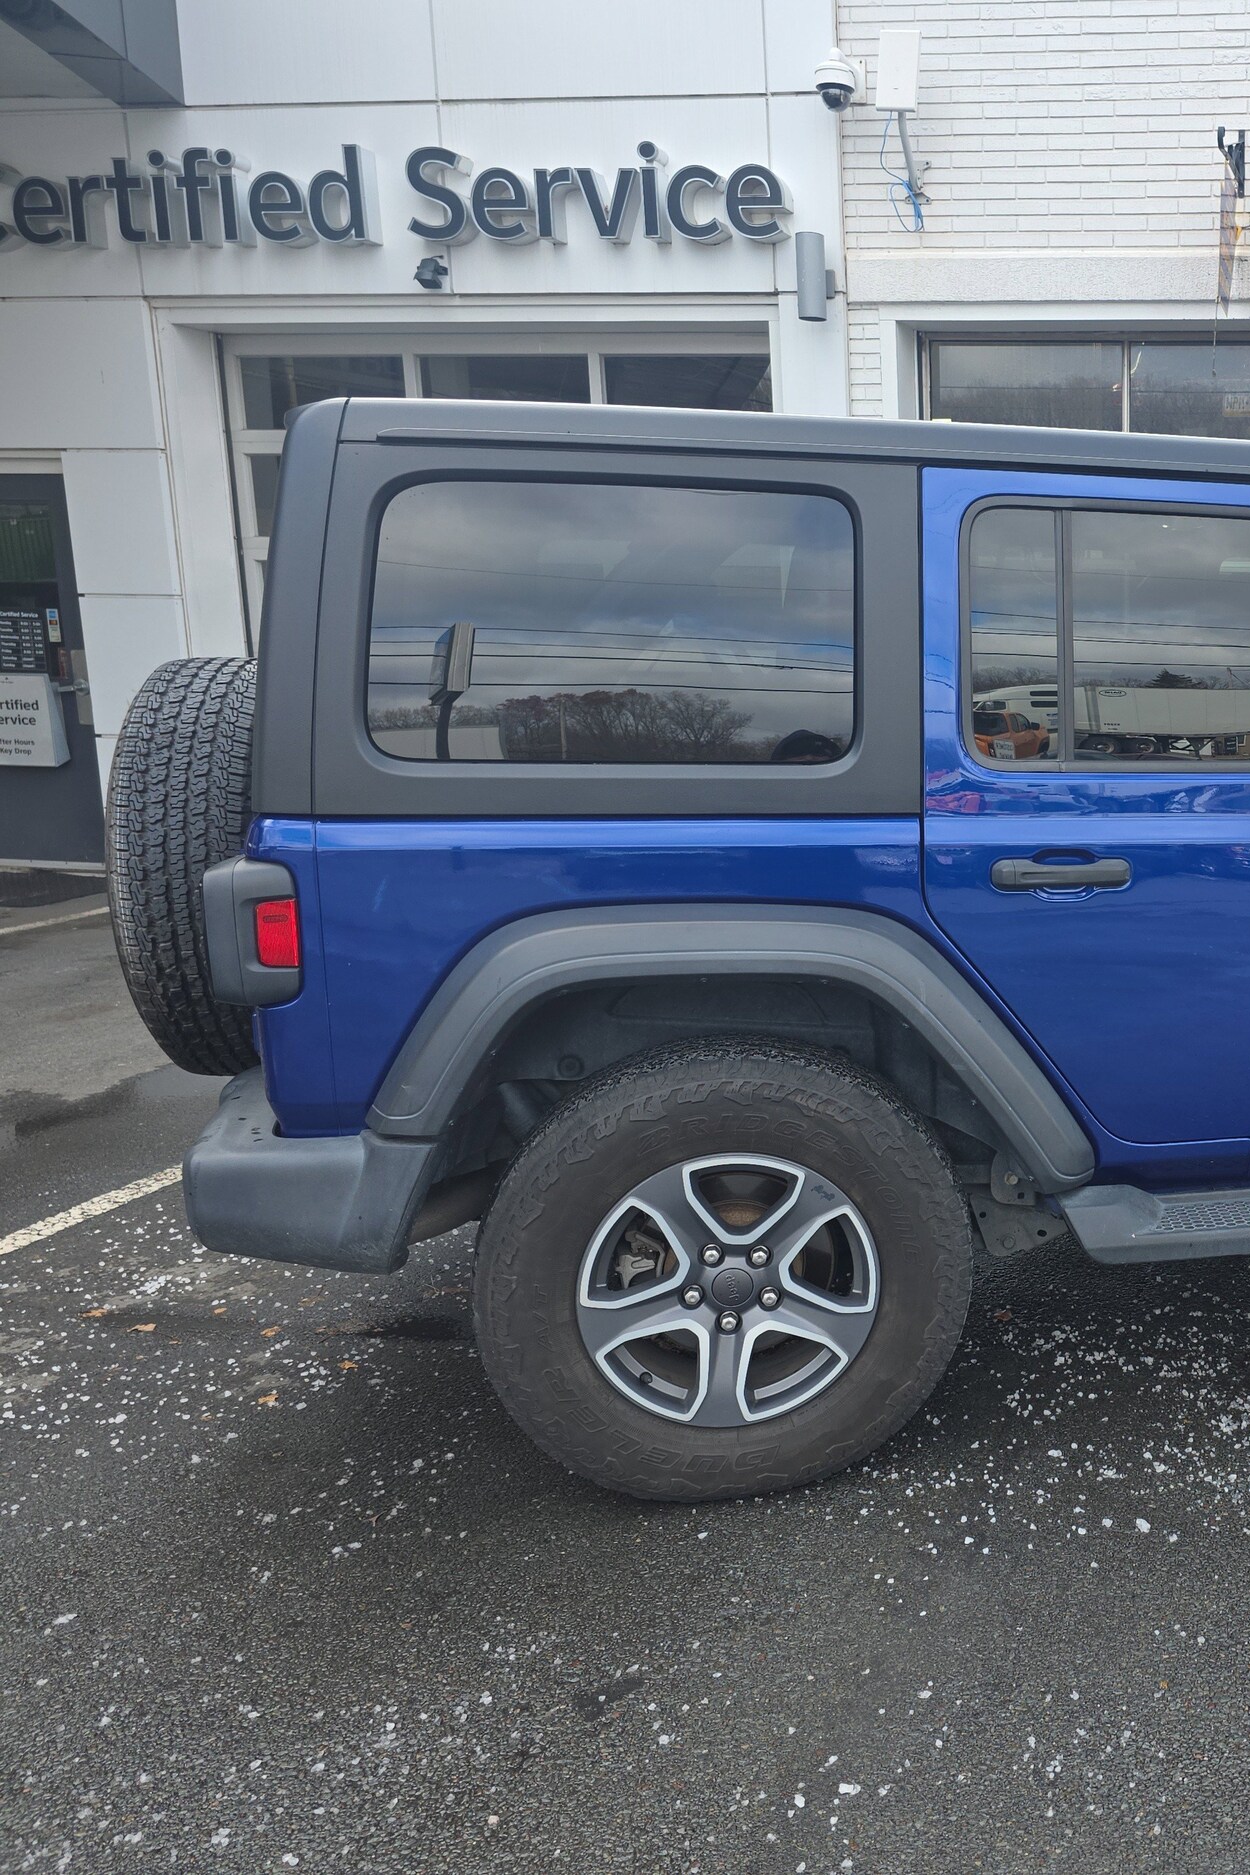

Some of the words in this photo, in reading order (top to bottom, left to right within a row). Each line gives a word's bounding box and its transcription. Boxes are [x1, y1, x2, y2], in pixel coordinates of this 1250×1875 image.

[0, 143, 376, 246] ertified
[405, 141, 792, 245] Service
[0, 699, 39, 711] rtified
[0, 714, 37, 726] ervice
[15, 748, 32, 756] Drop
